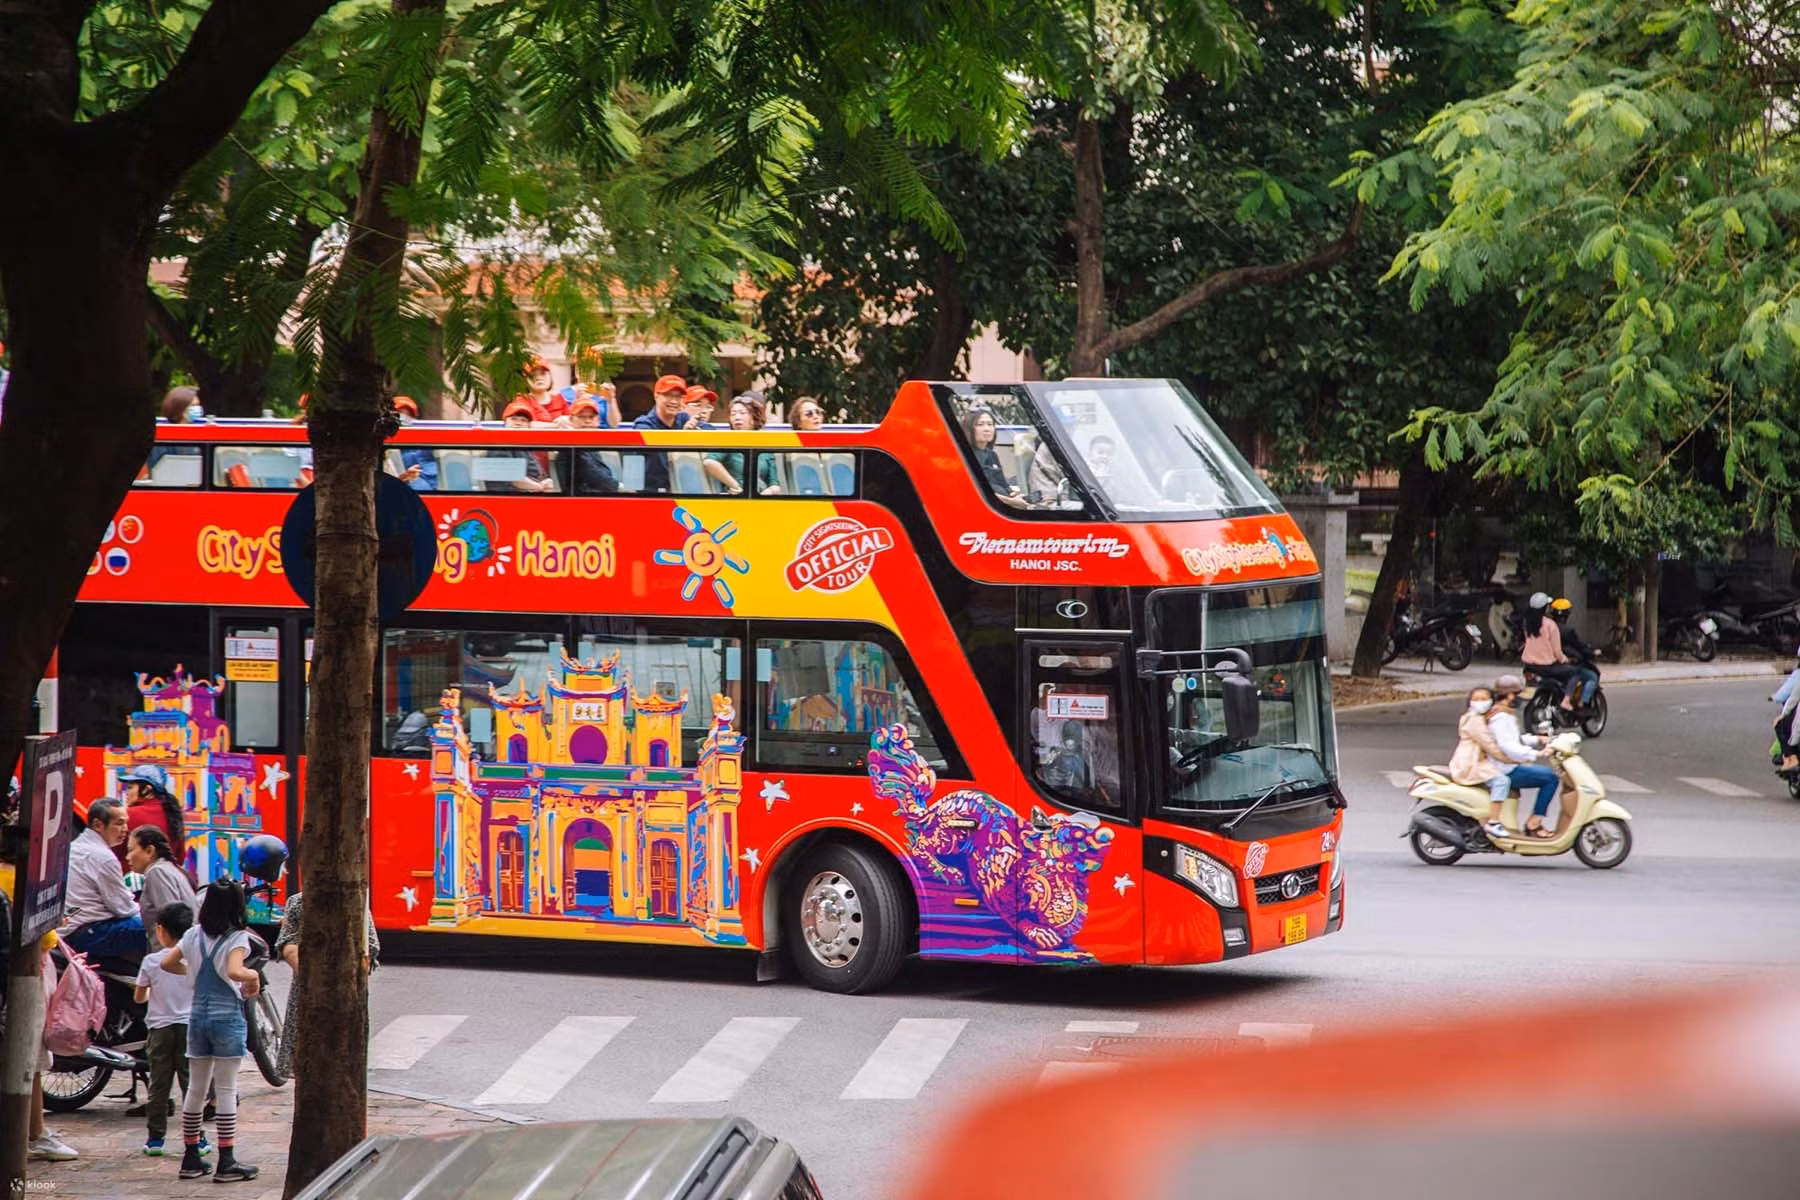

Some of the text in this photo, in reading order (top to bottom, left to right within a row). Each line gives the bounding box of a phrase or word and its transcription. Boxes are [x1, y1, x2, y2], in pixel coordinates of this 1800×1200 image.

[516, 530, 616, 579] Hanoi
[795, 531, 889, 583] OFFICIAL
[959, 531, 1130, 558] Vietnamtourism
[826, 561, 868, 588] TOUR
[1010, 559, 1082, 572] HANOI JSC.
[39, 770, 64, 882] P
